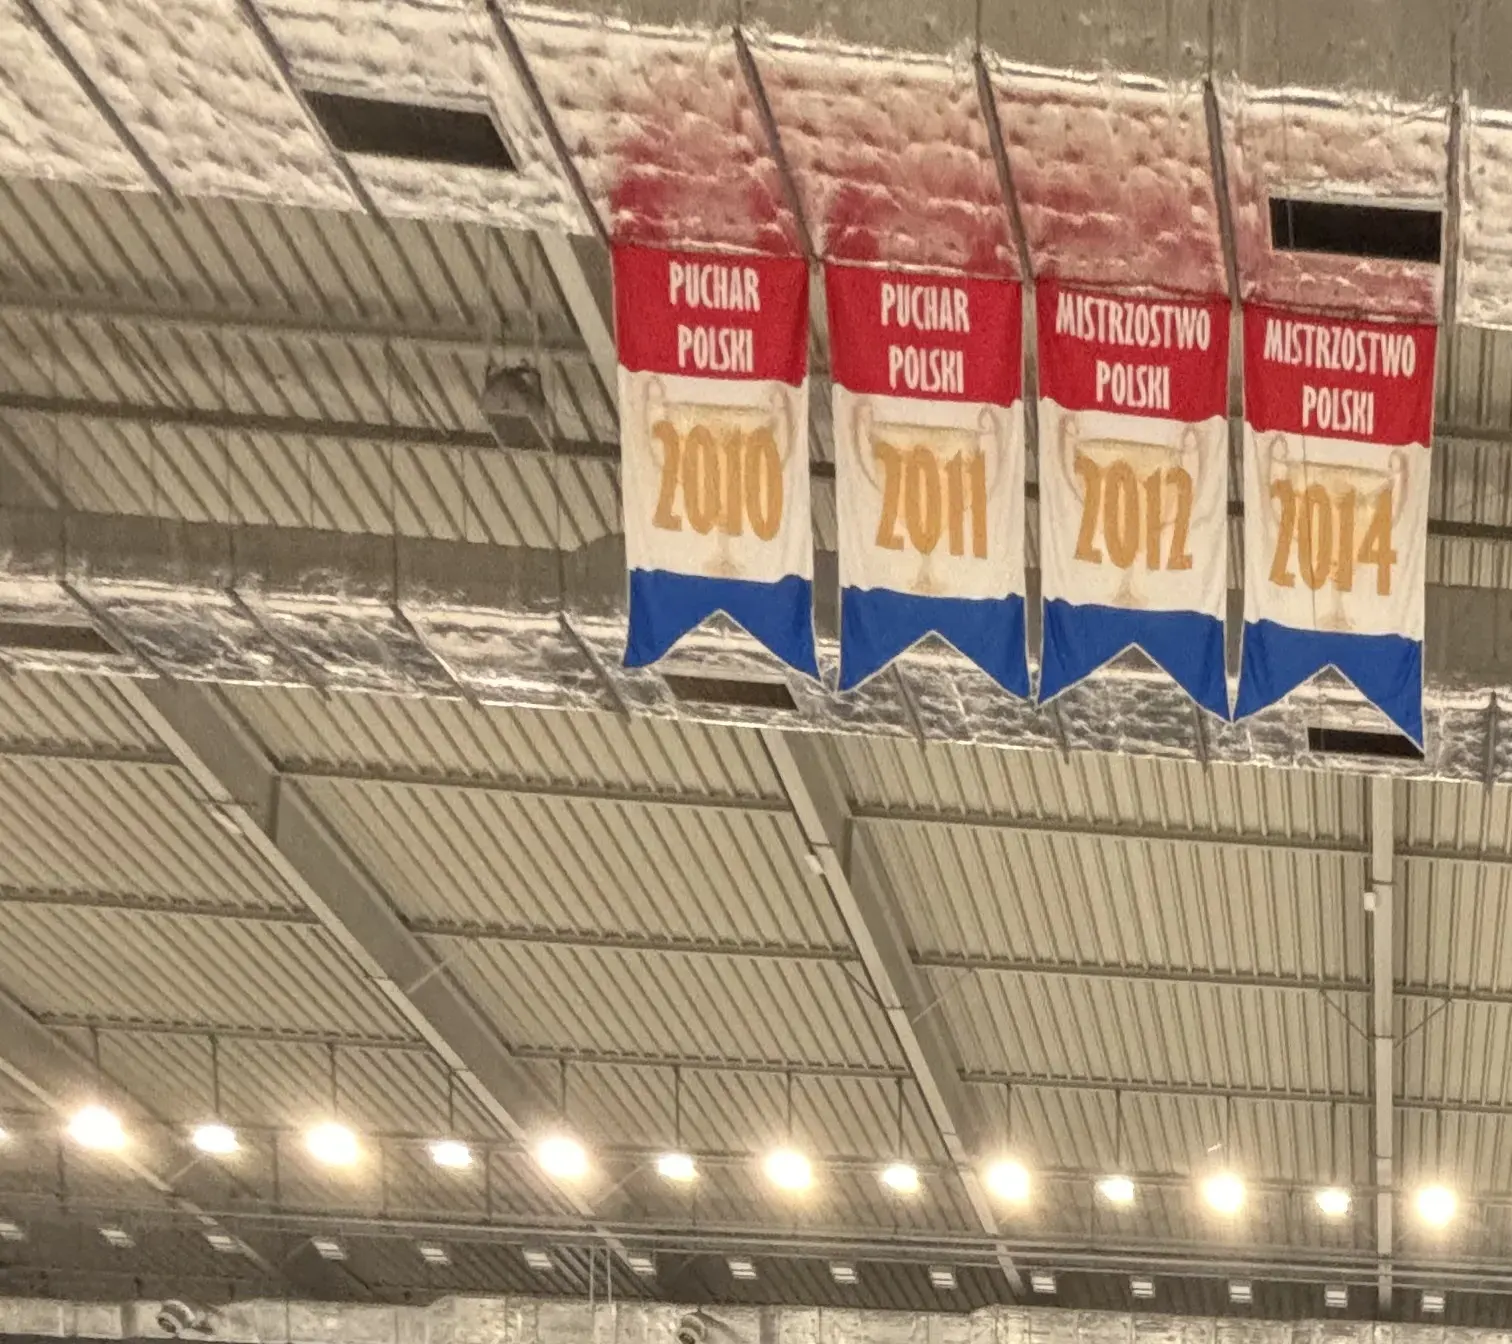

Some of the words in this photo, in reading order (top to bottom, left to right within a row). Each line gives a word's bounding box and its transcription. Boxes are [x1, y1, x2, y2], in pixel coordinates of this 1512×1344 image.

[669, 261, 760, 312] PUCHAR
[881, 282, 969, 333] PUCHAR
[677, 324, 754, 373] POLSKI
[1055, 293, 1211, 352] MISTRZOSTWO
[1264, 318, 1416, 377] MISTRZOSTWO
[889, 344, 965, 394] POLSKI
[1096, 360, 1170, 410] POLSKI
[1302, 385, 1375, 435] POLSKI
[653, 421, 784, 541] 2010
[874, 443, 988, 559] 2011
[1074, 454, 1194, 571] 2012
[1269, 479, 1398, 596] 2014
